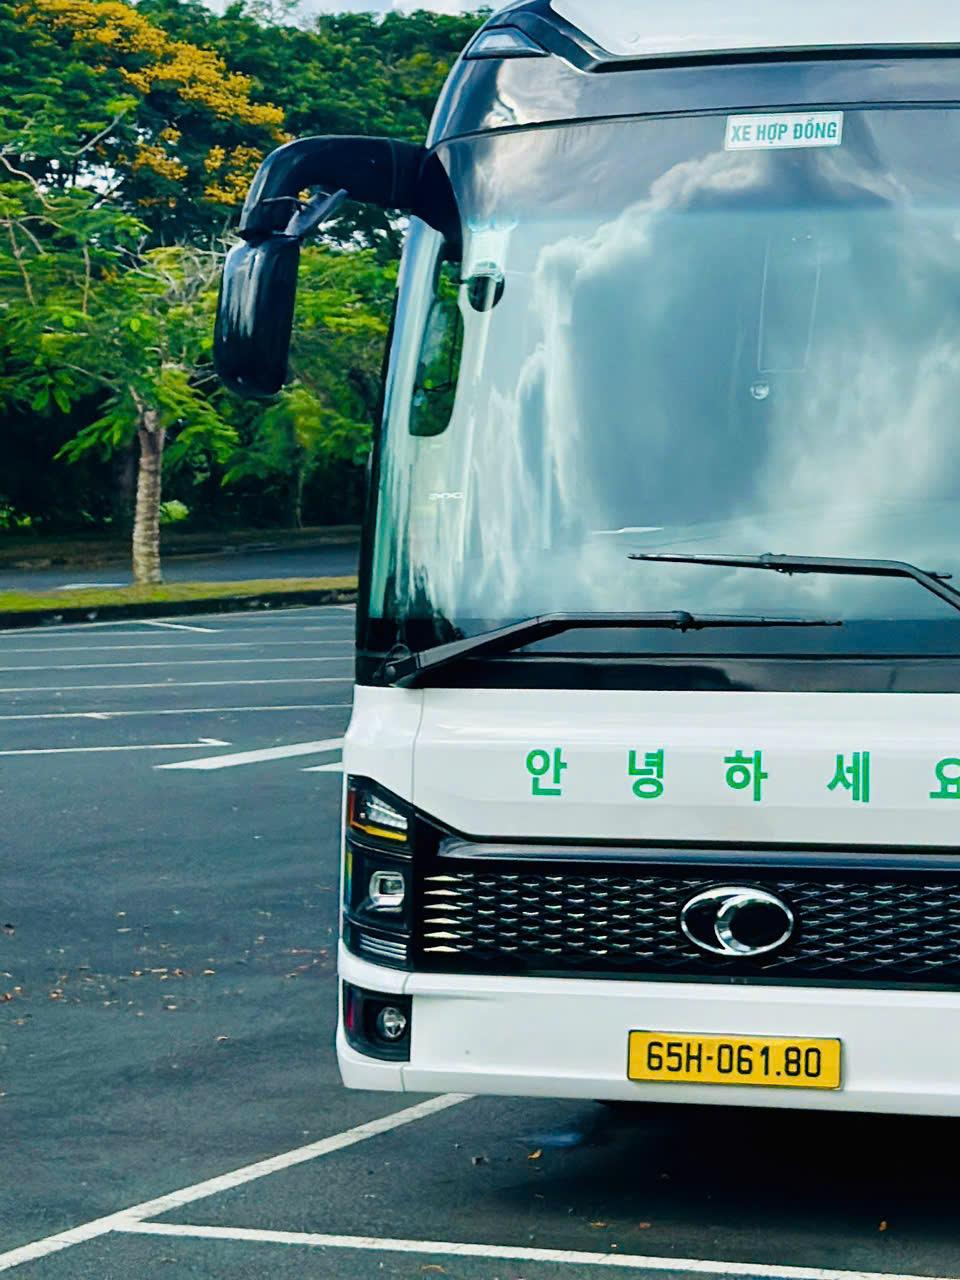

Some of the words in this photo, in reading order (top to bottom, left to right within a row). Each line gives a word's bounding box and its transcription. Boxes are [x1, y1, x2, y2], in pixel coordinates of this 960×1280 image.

[731, 125, 752, 142] XE
[756, 123, 788, 144] HỢP
[646, 1041, 821, 1078] 65H-061.80
